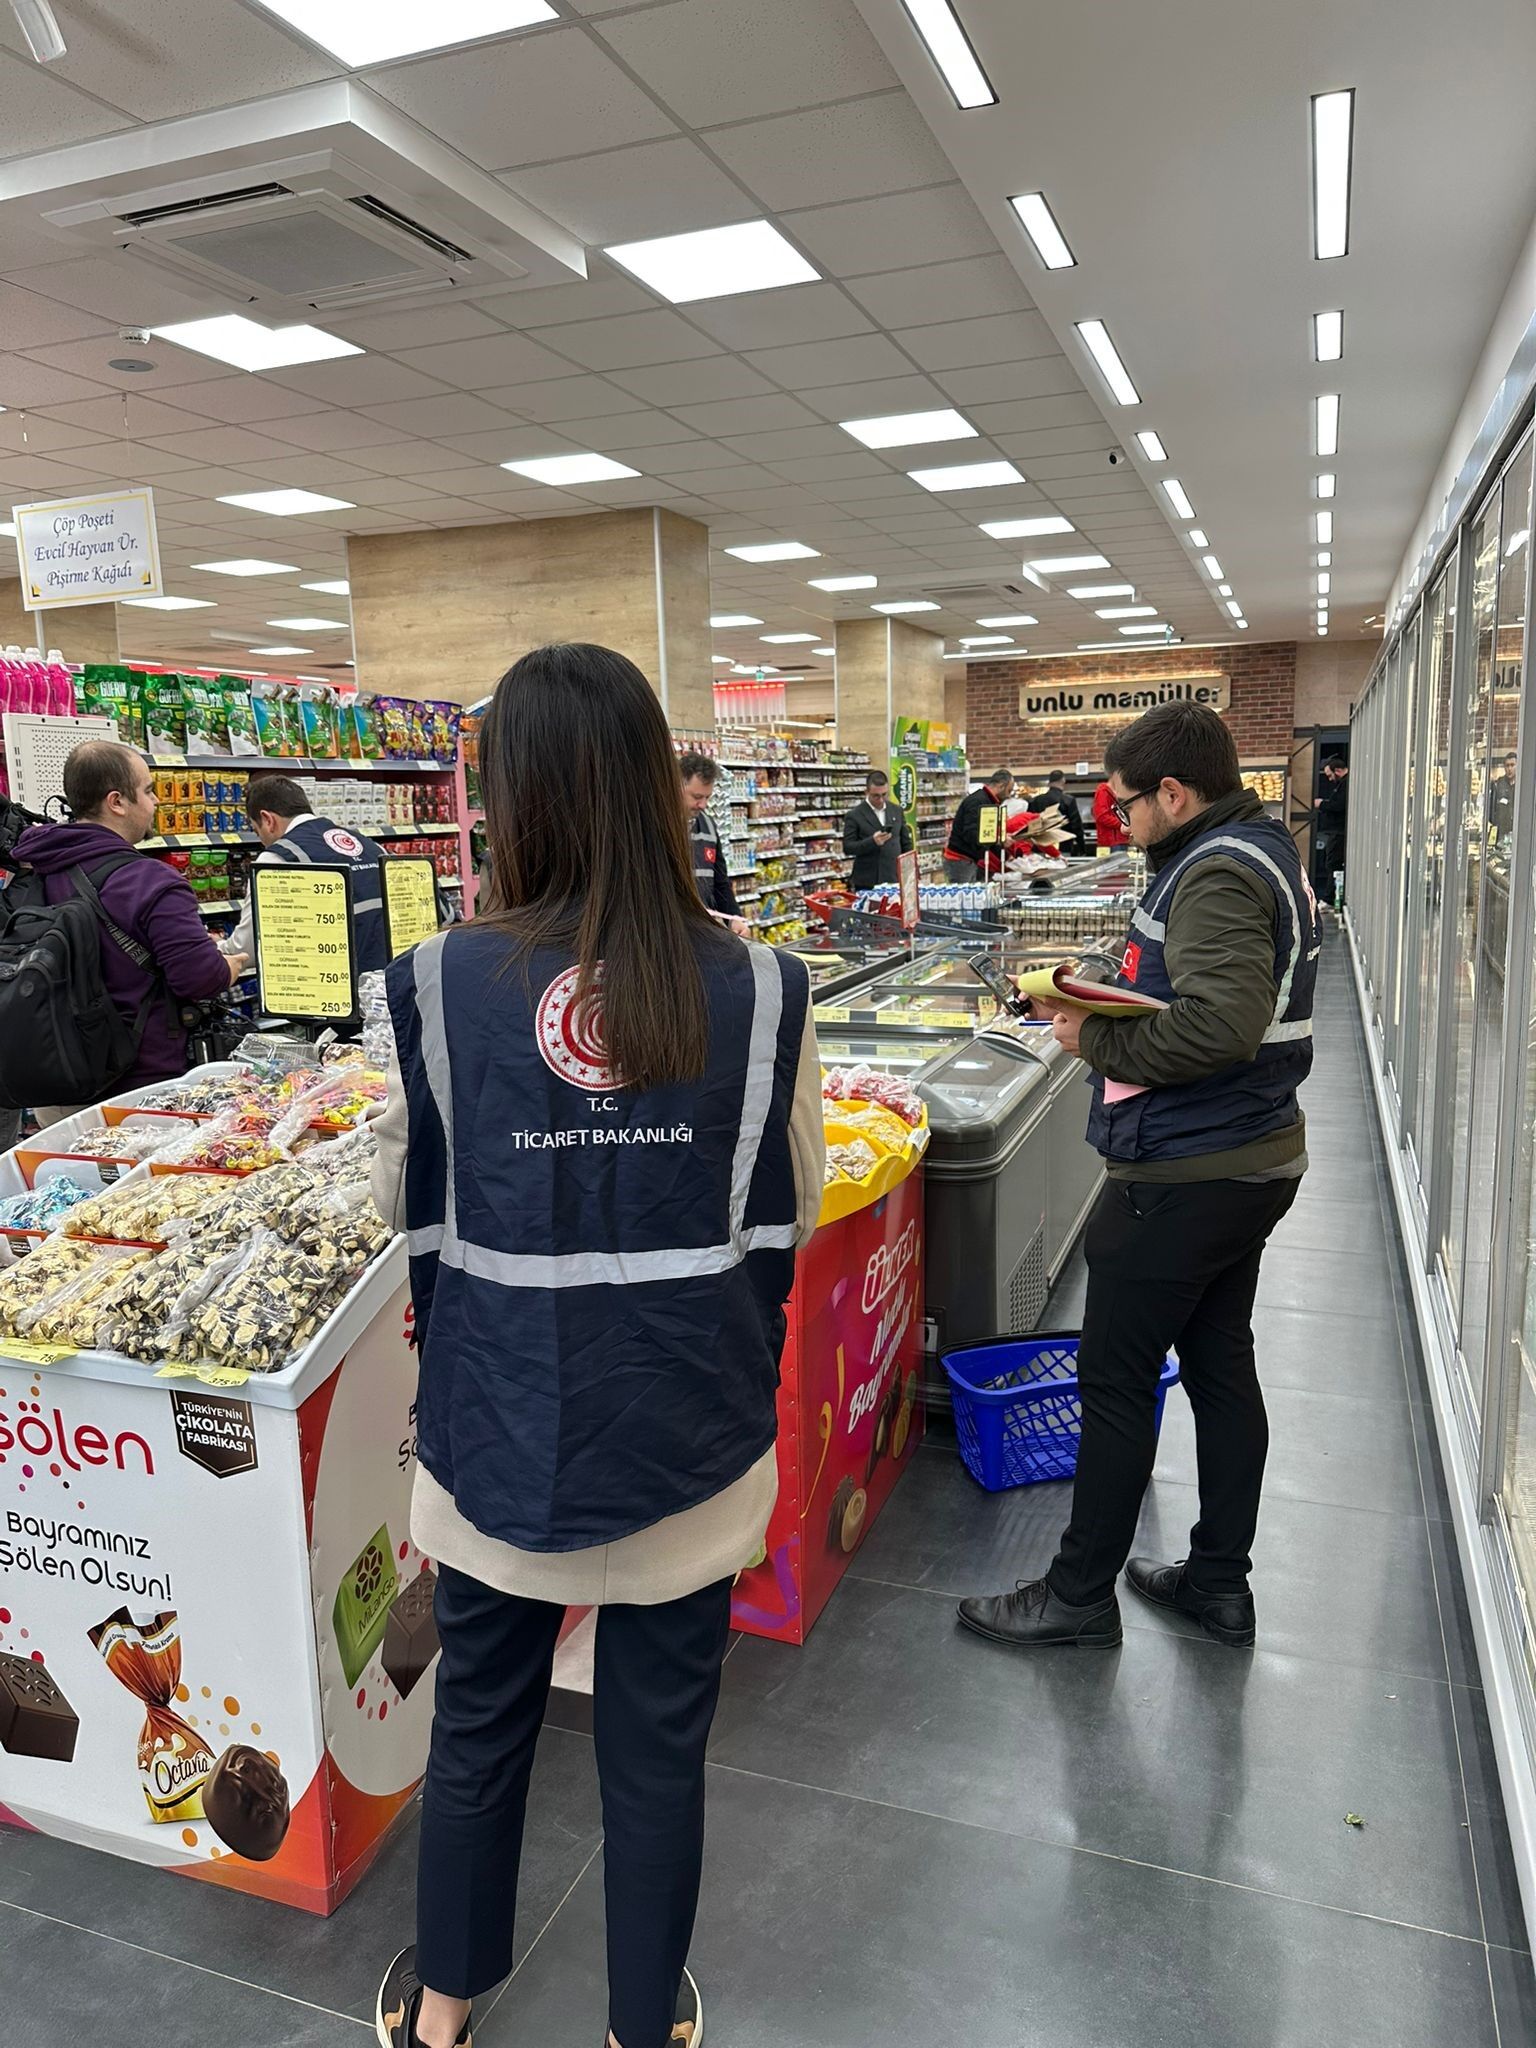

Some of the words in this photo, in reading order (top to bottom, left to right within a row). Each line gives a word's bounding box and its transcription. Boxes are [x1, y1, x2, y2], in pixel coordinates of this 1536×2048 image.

[53, 516, 75, 538] Çöp
[78, 510, 114, 531] Poşeti
[34, 541, 67, 561] Evcil
[68, 540, 114, 560] Hayvan
[118, 532, 138, 550] Ür.
[47, 570, 89, 588] Pişirme
[92, 561, 132, 584] Kağıdı
[1026, 692, 1083, 713] unlu
[1093, 683, 1222, 709] mamüller
[586, 1097, 618, 1112] T.C.
[511, 1129, 589, 1149] TİCARET
[592, 1123, 693, 1145] BAKANLIĞI
[181, 1402, 243, 1420] TÜRKİYE'NİN
[176, 1412, 254, 1440] ÇİKOLATA
[186, 1432, 248, 1452] FABRİKASI
[7, 1511, 151, 1559] Bayramınız
[0, 1540, 75, 1581] Şölen
[81, 1557, 172, 1601] Olsun!
[155, 1750, 211, 1794] Octavia
